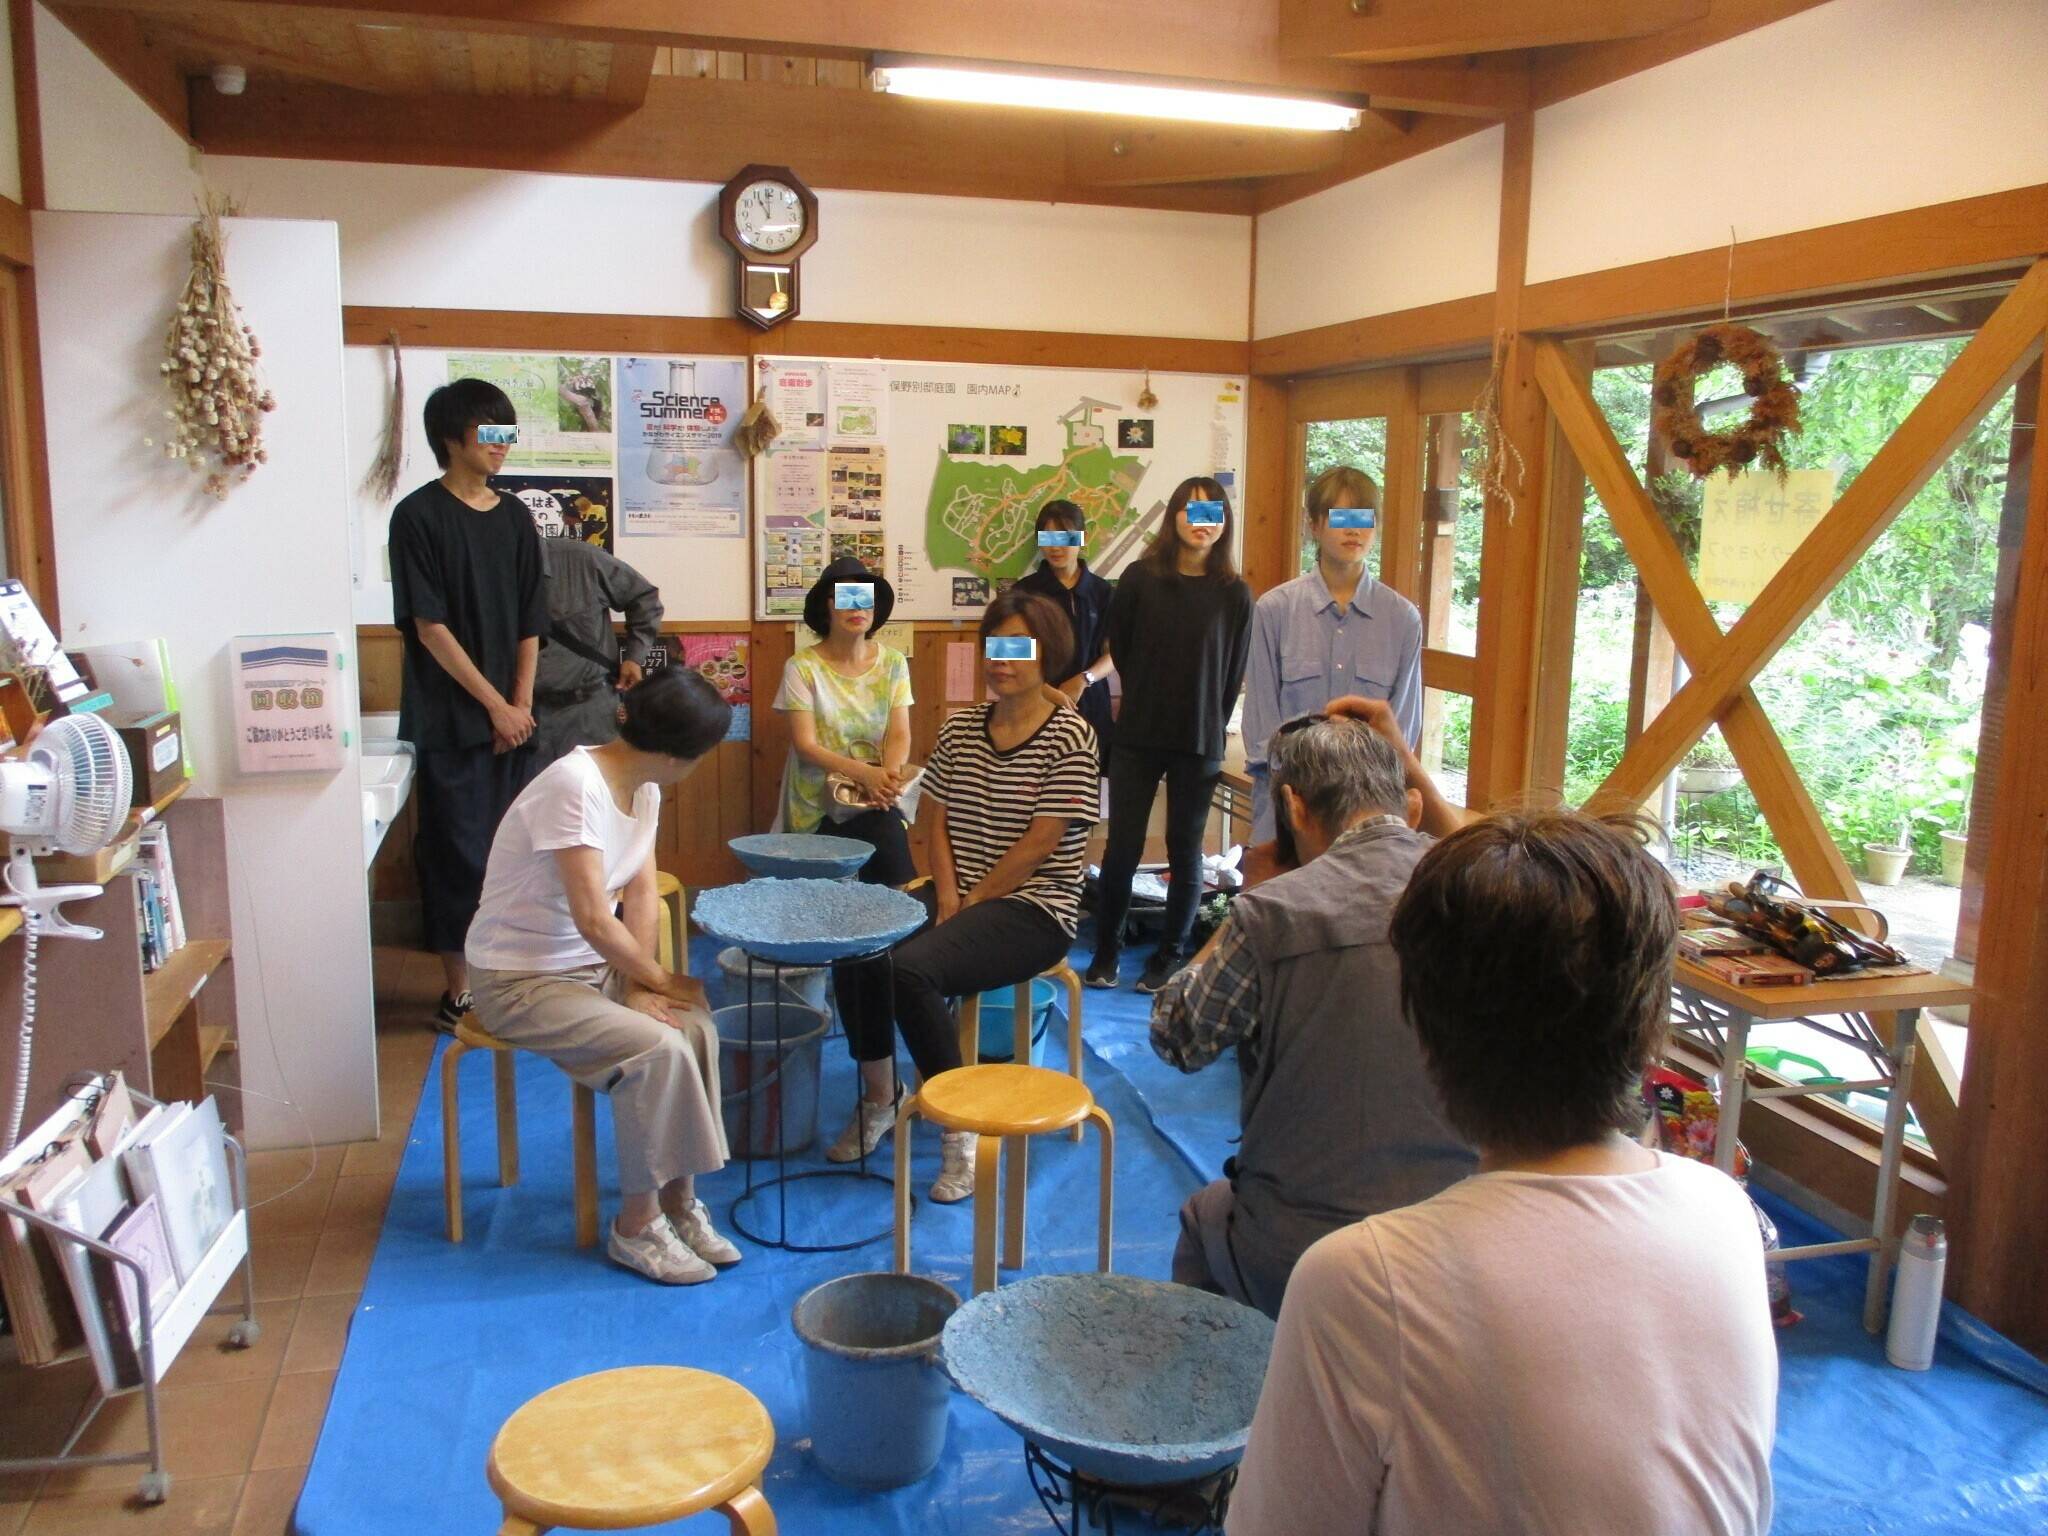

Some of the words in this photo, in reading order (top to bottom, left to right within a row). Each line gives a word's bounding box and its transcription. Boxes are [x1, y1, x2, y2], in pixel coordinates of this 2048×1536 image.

[753, 190, 761, 200] 11
[764, 187, 774, 199] 12
[744, 198, 753, 209] 10
[742, 210, 748, 220] 9
[790, 212, 796, 222] 3
[745, 223, 752, 232] 8
[754, 231, 761, 242] 7
[766, 236, 773, 245] 6
[778, 233, 785, 242] 5
[652, 390, 720, 408] Science
[640, 402, 709, 419] Summer
[523, 496, 555, 509] こはま
